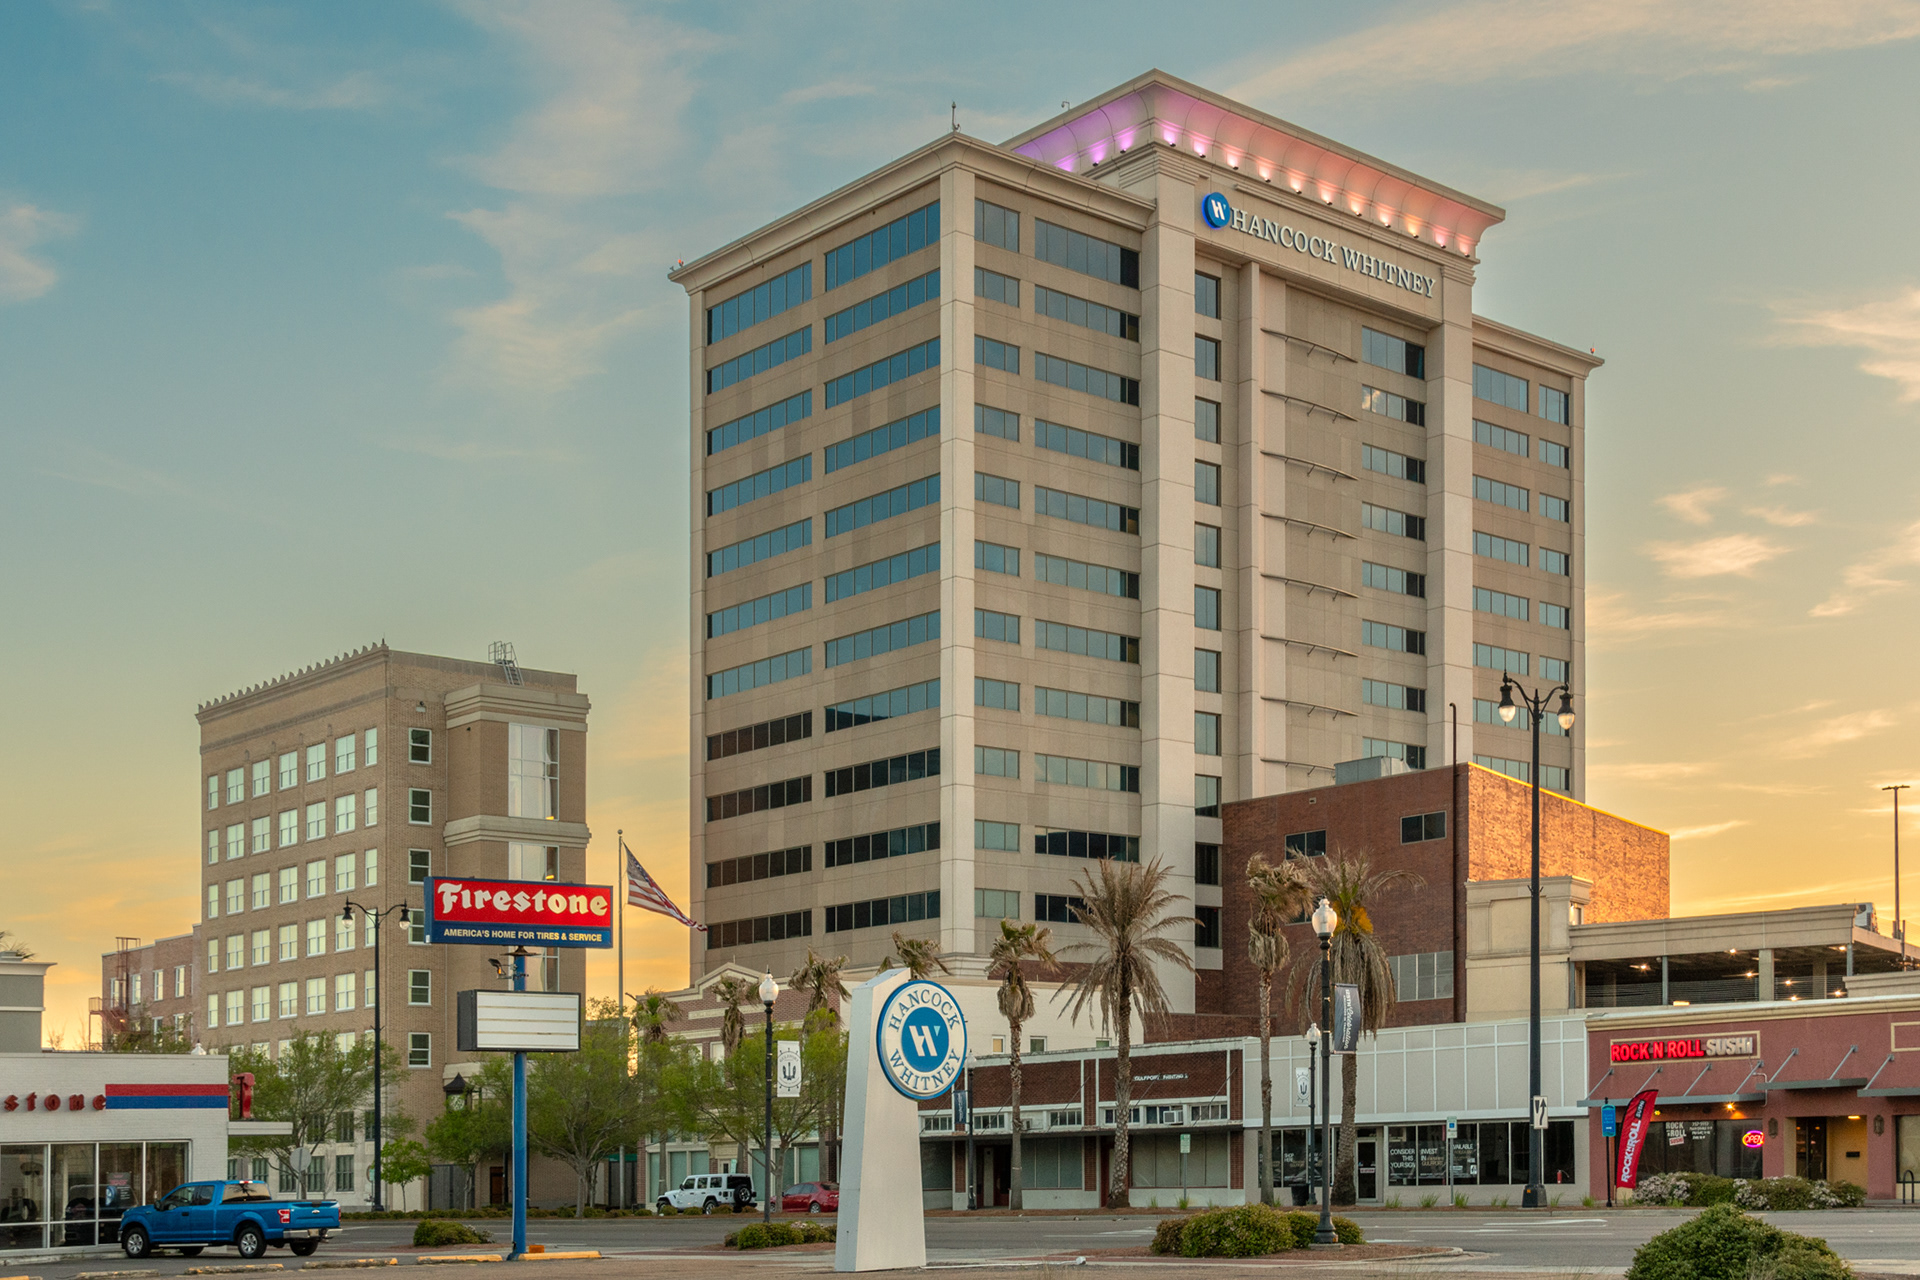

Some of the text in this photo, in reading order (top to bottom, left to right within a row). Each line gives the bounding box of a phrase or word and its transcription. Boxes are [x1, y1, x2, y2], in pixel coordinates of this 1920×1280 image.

[1230, 206, 1437, 298] HANCOCK WHITNEY
[437, 882, 608, 916] Firestone
[443, 928, 602, 942] AMERICA'S HOME FOR TIRES & SERVICE
[888, 989, 960, 1033] HANCOCK
[1611, 1036, 1753, 1061] ROCK N ROLL SUSHI
[889, 1048, 960, 1091] WHITNEY
[1665, 1122, 1684, 1130] ROCK
[1745, 1135, 1764, 1144] OPEN
